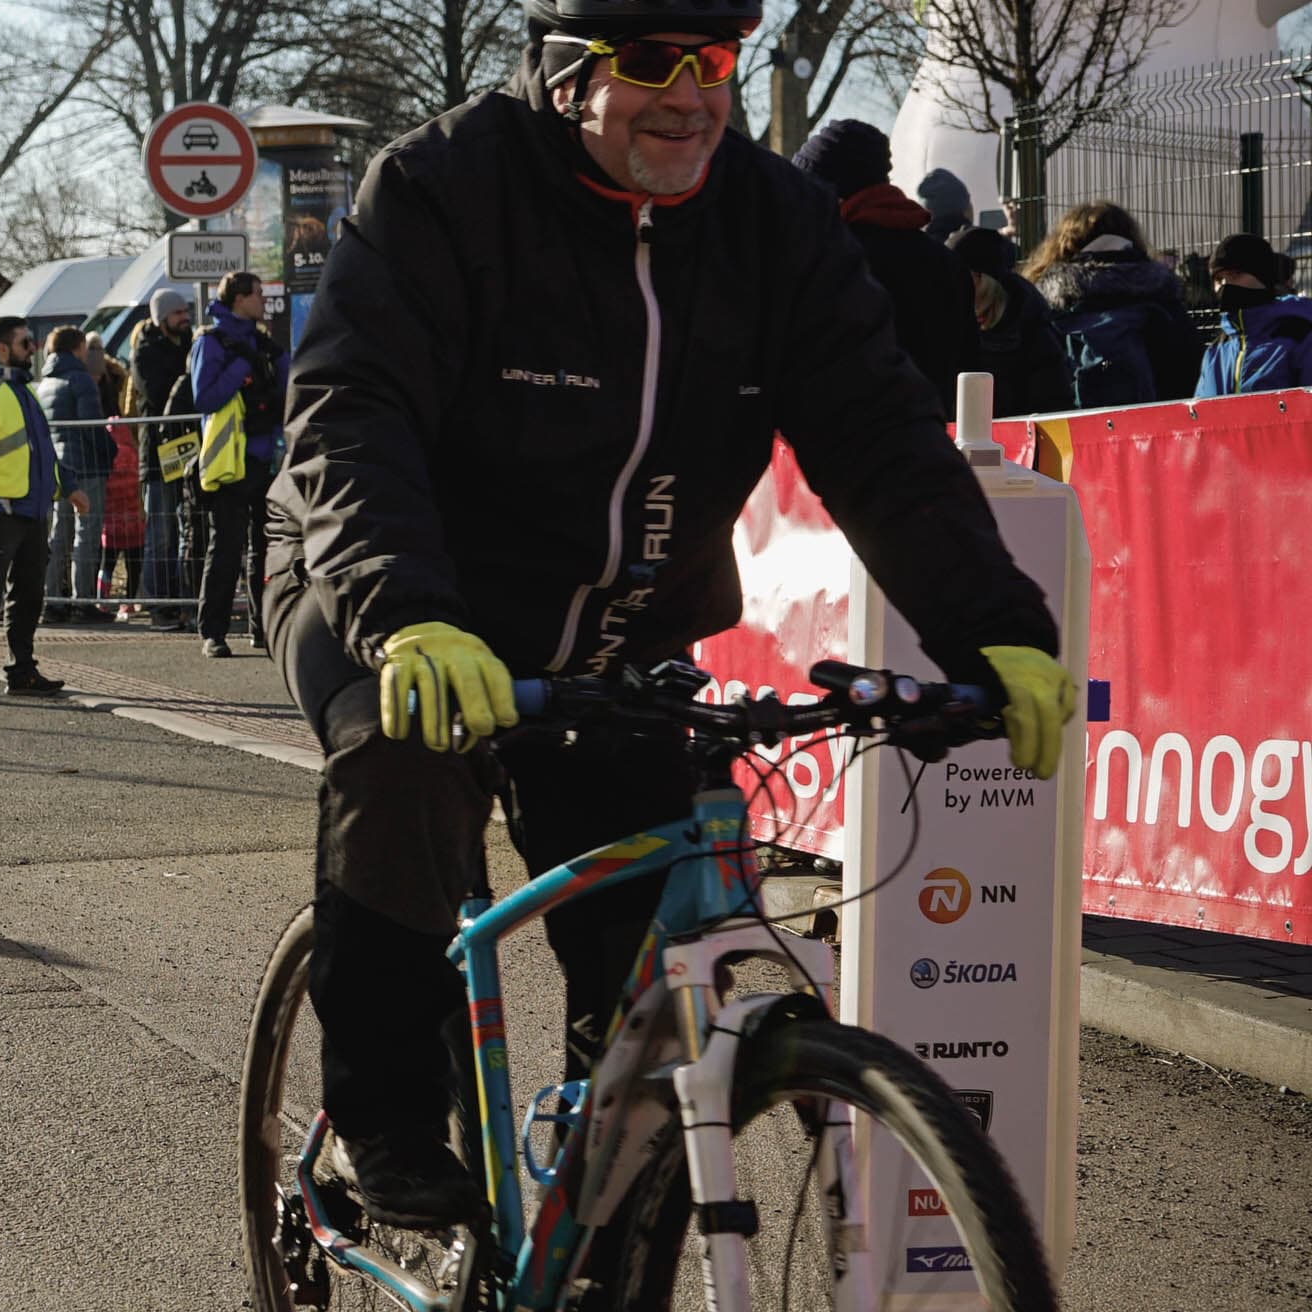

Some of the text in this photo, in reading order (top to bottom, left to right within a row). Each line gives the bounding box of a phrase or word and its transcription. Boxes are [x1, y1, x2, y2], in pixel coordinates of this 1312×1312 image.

[194, 241, 223, 254] MIMO
[945, 788, 1035, 814] by MVM
[980, 884, 1017, 904] NN
[943, 960, 1017, 984] ŠKODA
[932, 1040, 1009, 1059] RUNTO
